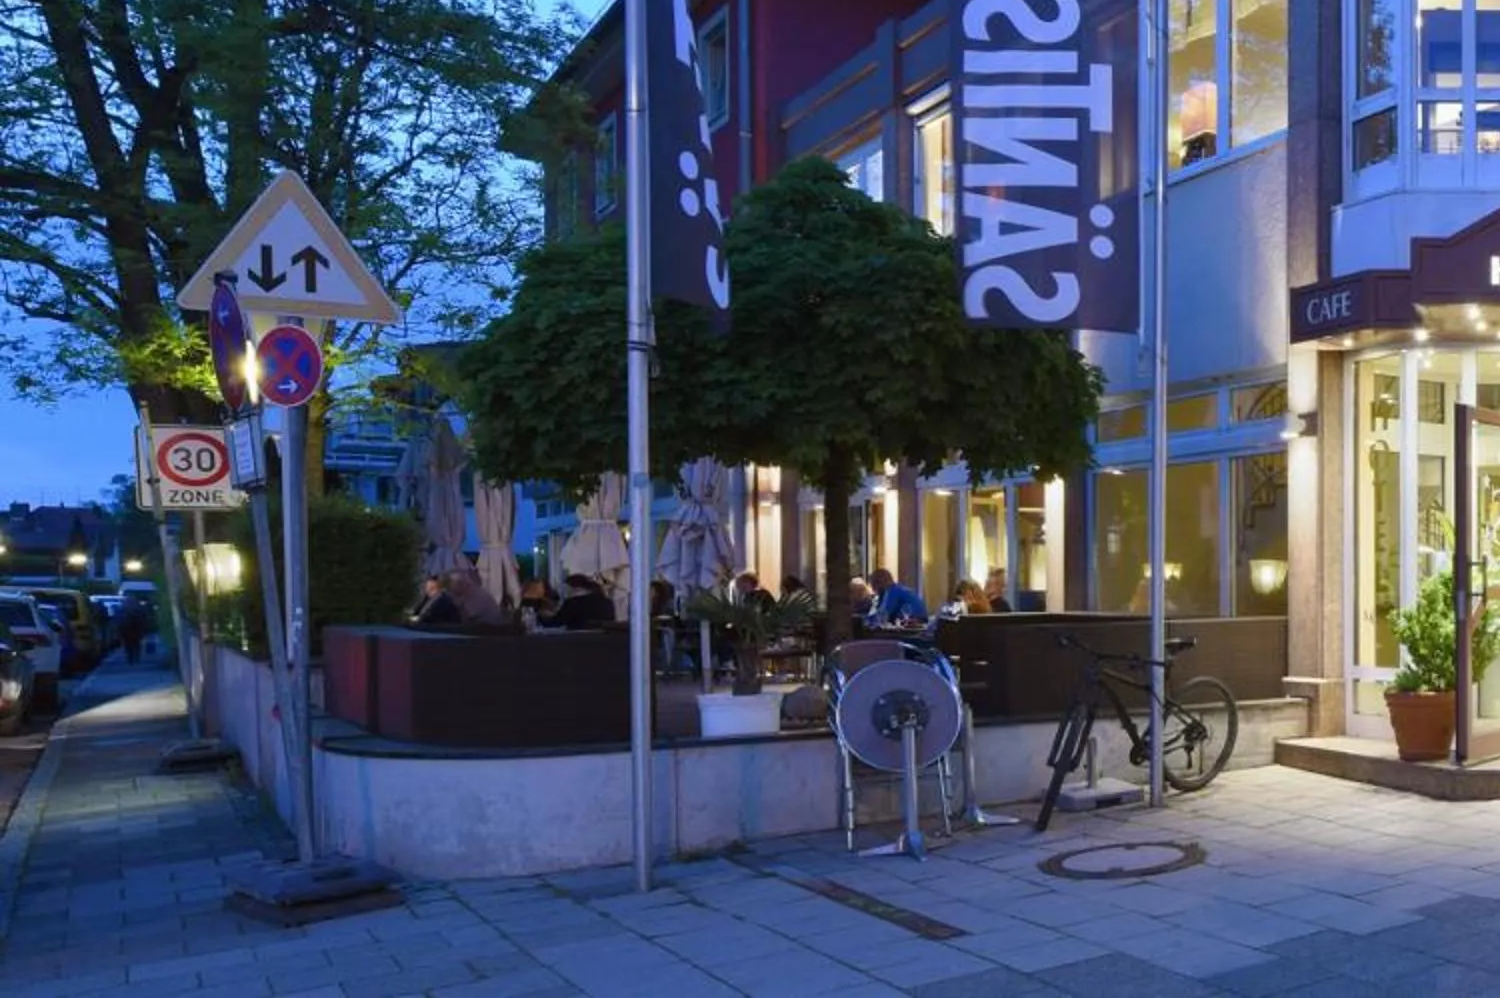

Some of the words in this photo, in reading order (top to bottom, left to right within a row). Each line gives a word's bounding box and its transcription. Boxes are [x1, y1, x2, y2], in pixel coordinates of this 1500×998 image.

[1306, 290, 1352, 325] CAFE
[172, 447, 216, 473] 30
[168, 489, 225, 504] ZONE
